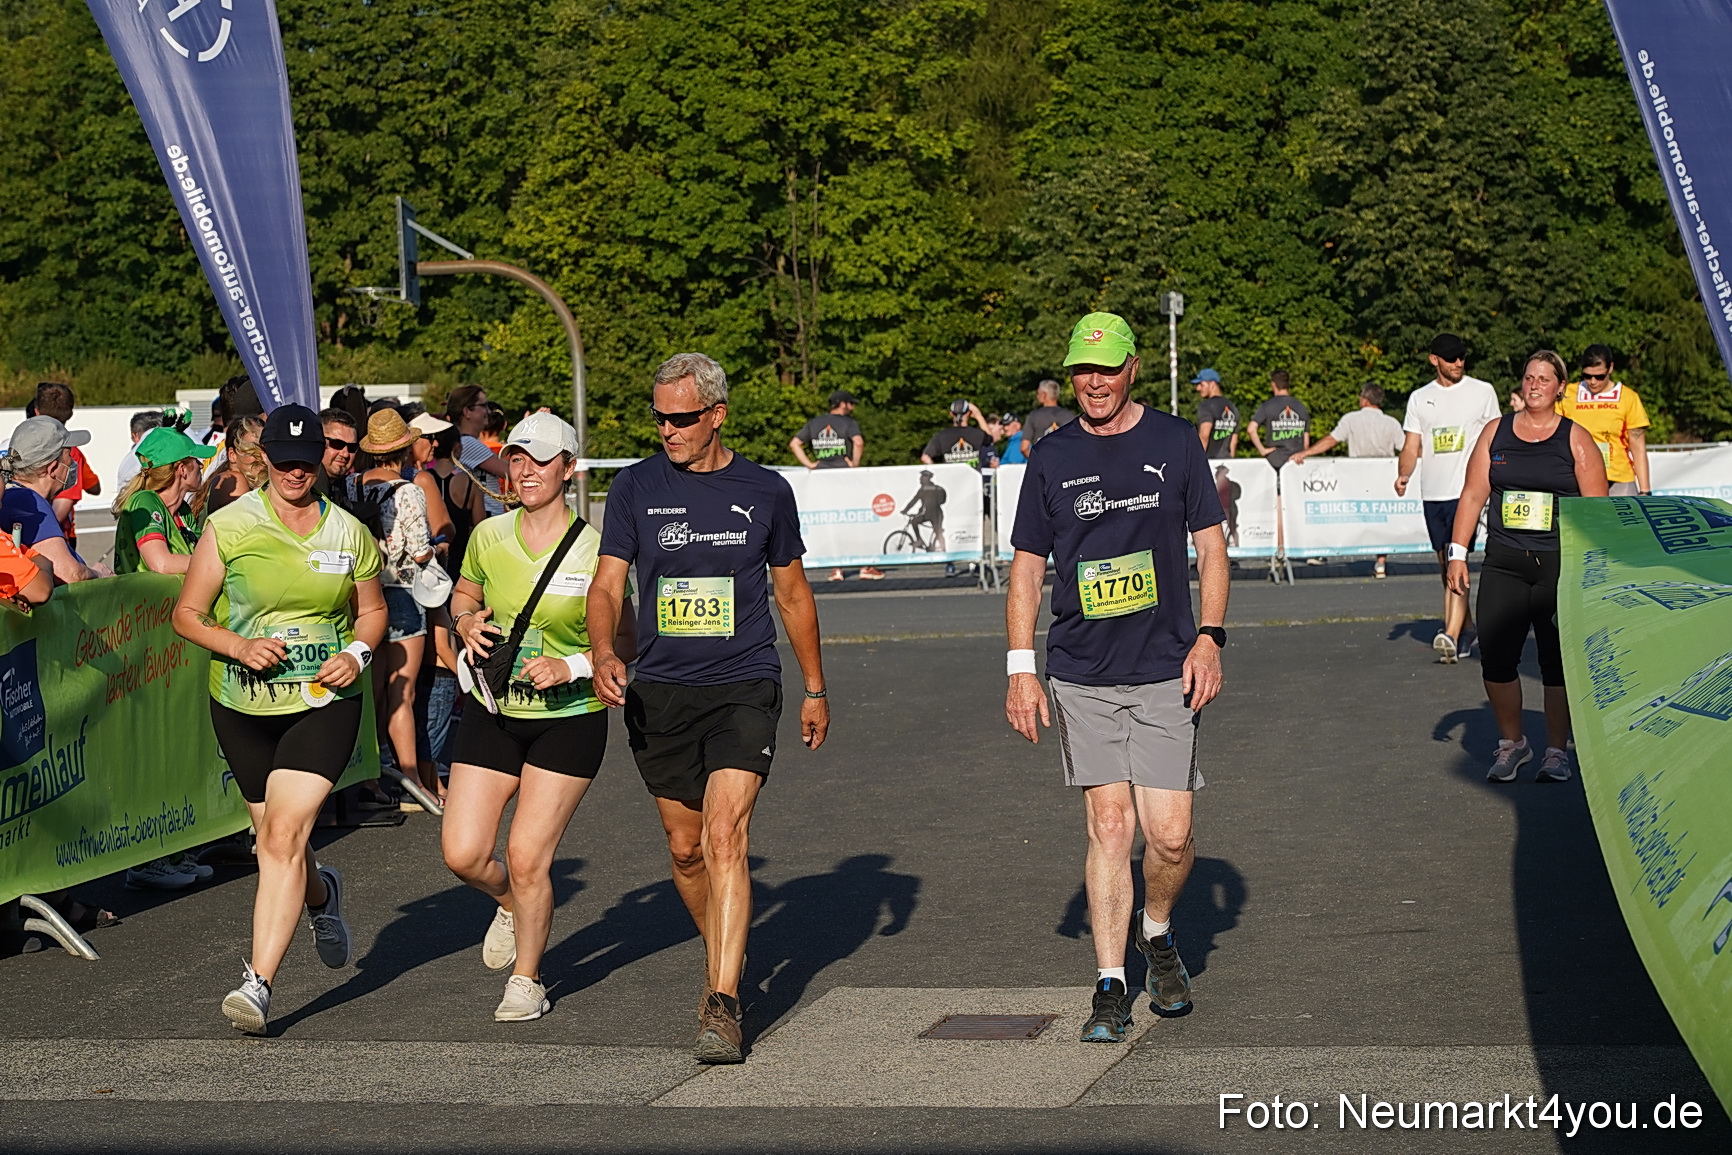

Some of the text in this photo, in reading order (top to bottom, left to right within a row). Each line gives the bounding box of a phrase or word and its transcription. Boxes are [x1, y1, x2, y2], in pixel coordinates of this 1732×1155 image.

[1597, 402, 1619, 410] BÖGL
[1438, 434, 1457, 445] 114
[1068, 475, 1101, 488] PFLEIDERER
[1303, 479, 1338, 493] NOW
[1105, 492, 1160, 511] Firmenlauf
[1126, 502, 1160, 513] neumarkt
[1306, 502, 1358, 514] E-BIKES
[1360, 502, 1370, 513] &
[653, 507, 687, 515] PFLEIDERER
[799, 508, 874, 526] AHRRÄDER
[689, 530, 748, 543] Firmenlauf
[712, 539, 747, 547] neumarkt
[1092, 573, 1143, 599] 1770
[1144, 572, 1154, 599] 2022
[1083, 584, 1094, 612] WALK
[1093, 597, 1127, 608] Landmann
[1128, 591, 1148, 602] Rudolf
[668, 598, 720, 617] 1783
[722, 601, 730, 628] 2022
[668, 619, 701, 627] Reisinger
[76, 601, 132, 668] Gesunde
[105, 638, 190, 706] laufen länger!
[5, 680, 32, 709] Fischer
[0, 714, 89, 825] menlauf
